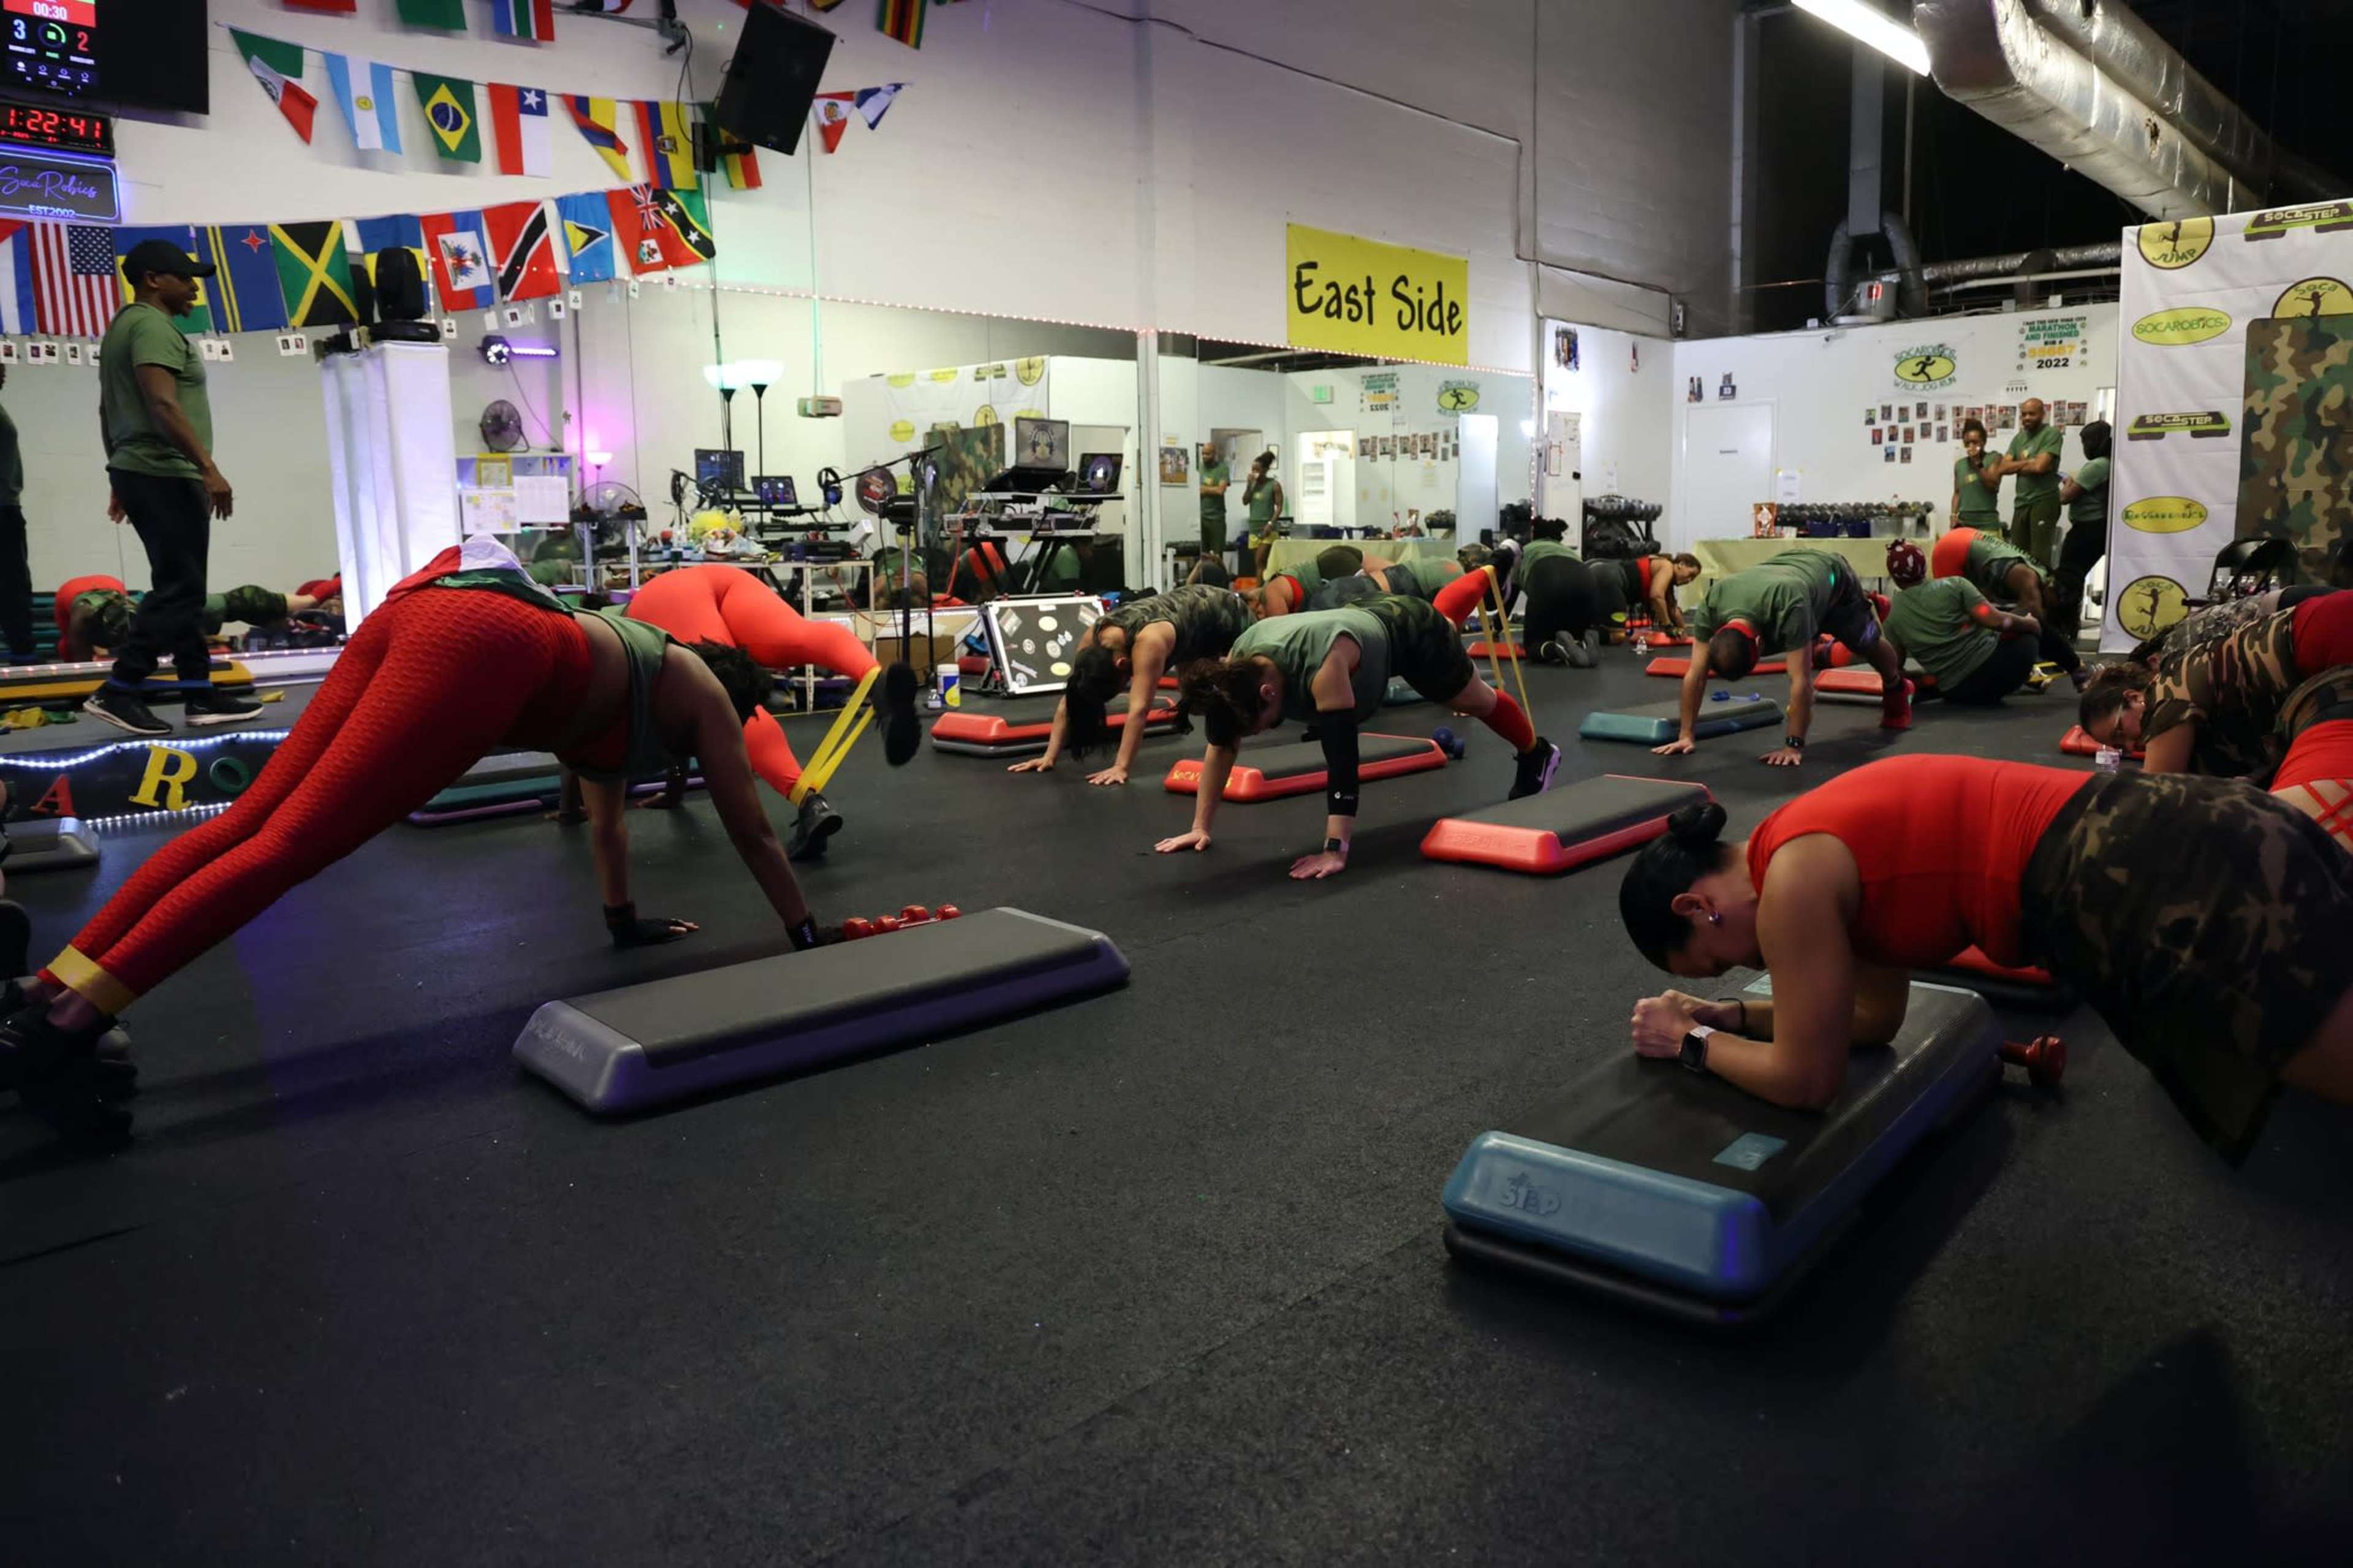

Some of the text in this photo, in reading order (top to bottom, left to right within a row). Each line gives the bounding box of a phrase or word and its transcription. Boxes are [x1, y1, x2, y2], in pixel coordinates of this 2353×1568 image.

[33, 1, 67, 21] 00:30
[13, 18, 26, 40] 3
[77, 31, 89, 51] 2
[2151, 248, 2197, 263] JUMP
[1294, 261, 1462, 336] East Side
[2025, 330, 2079, 341] AND FINISHED
[2028, 322, 2077, 332] MARATHON
[2036, 357, 2069, 369] 2022
